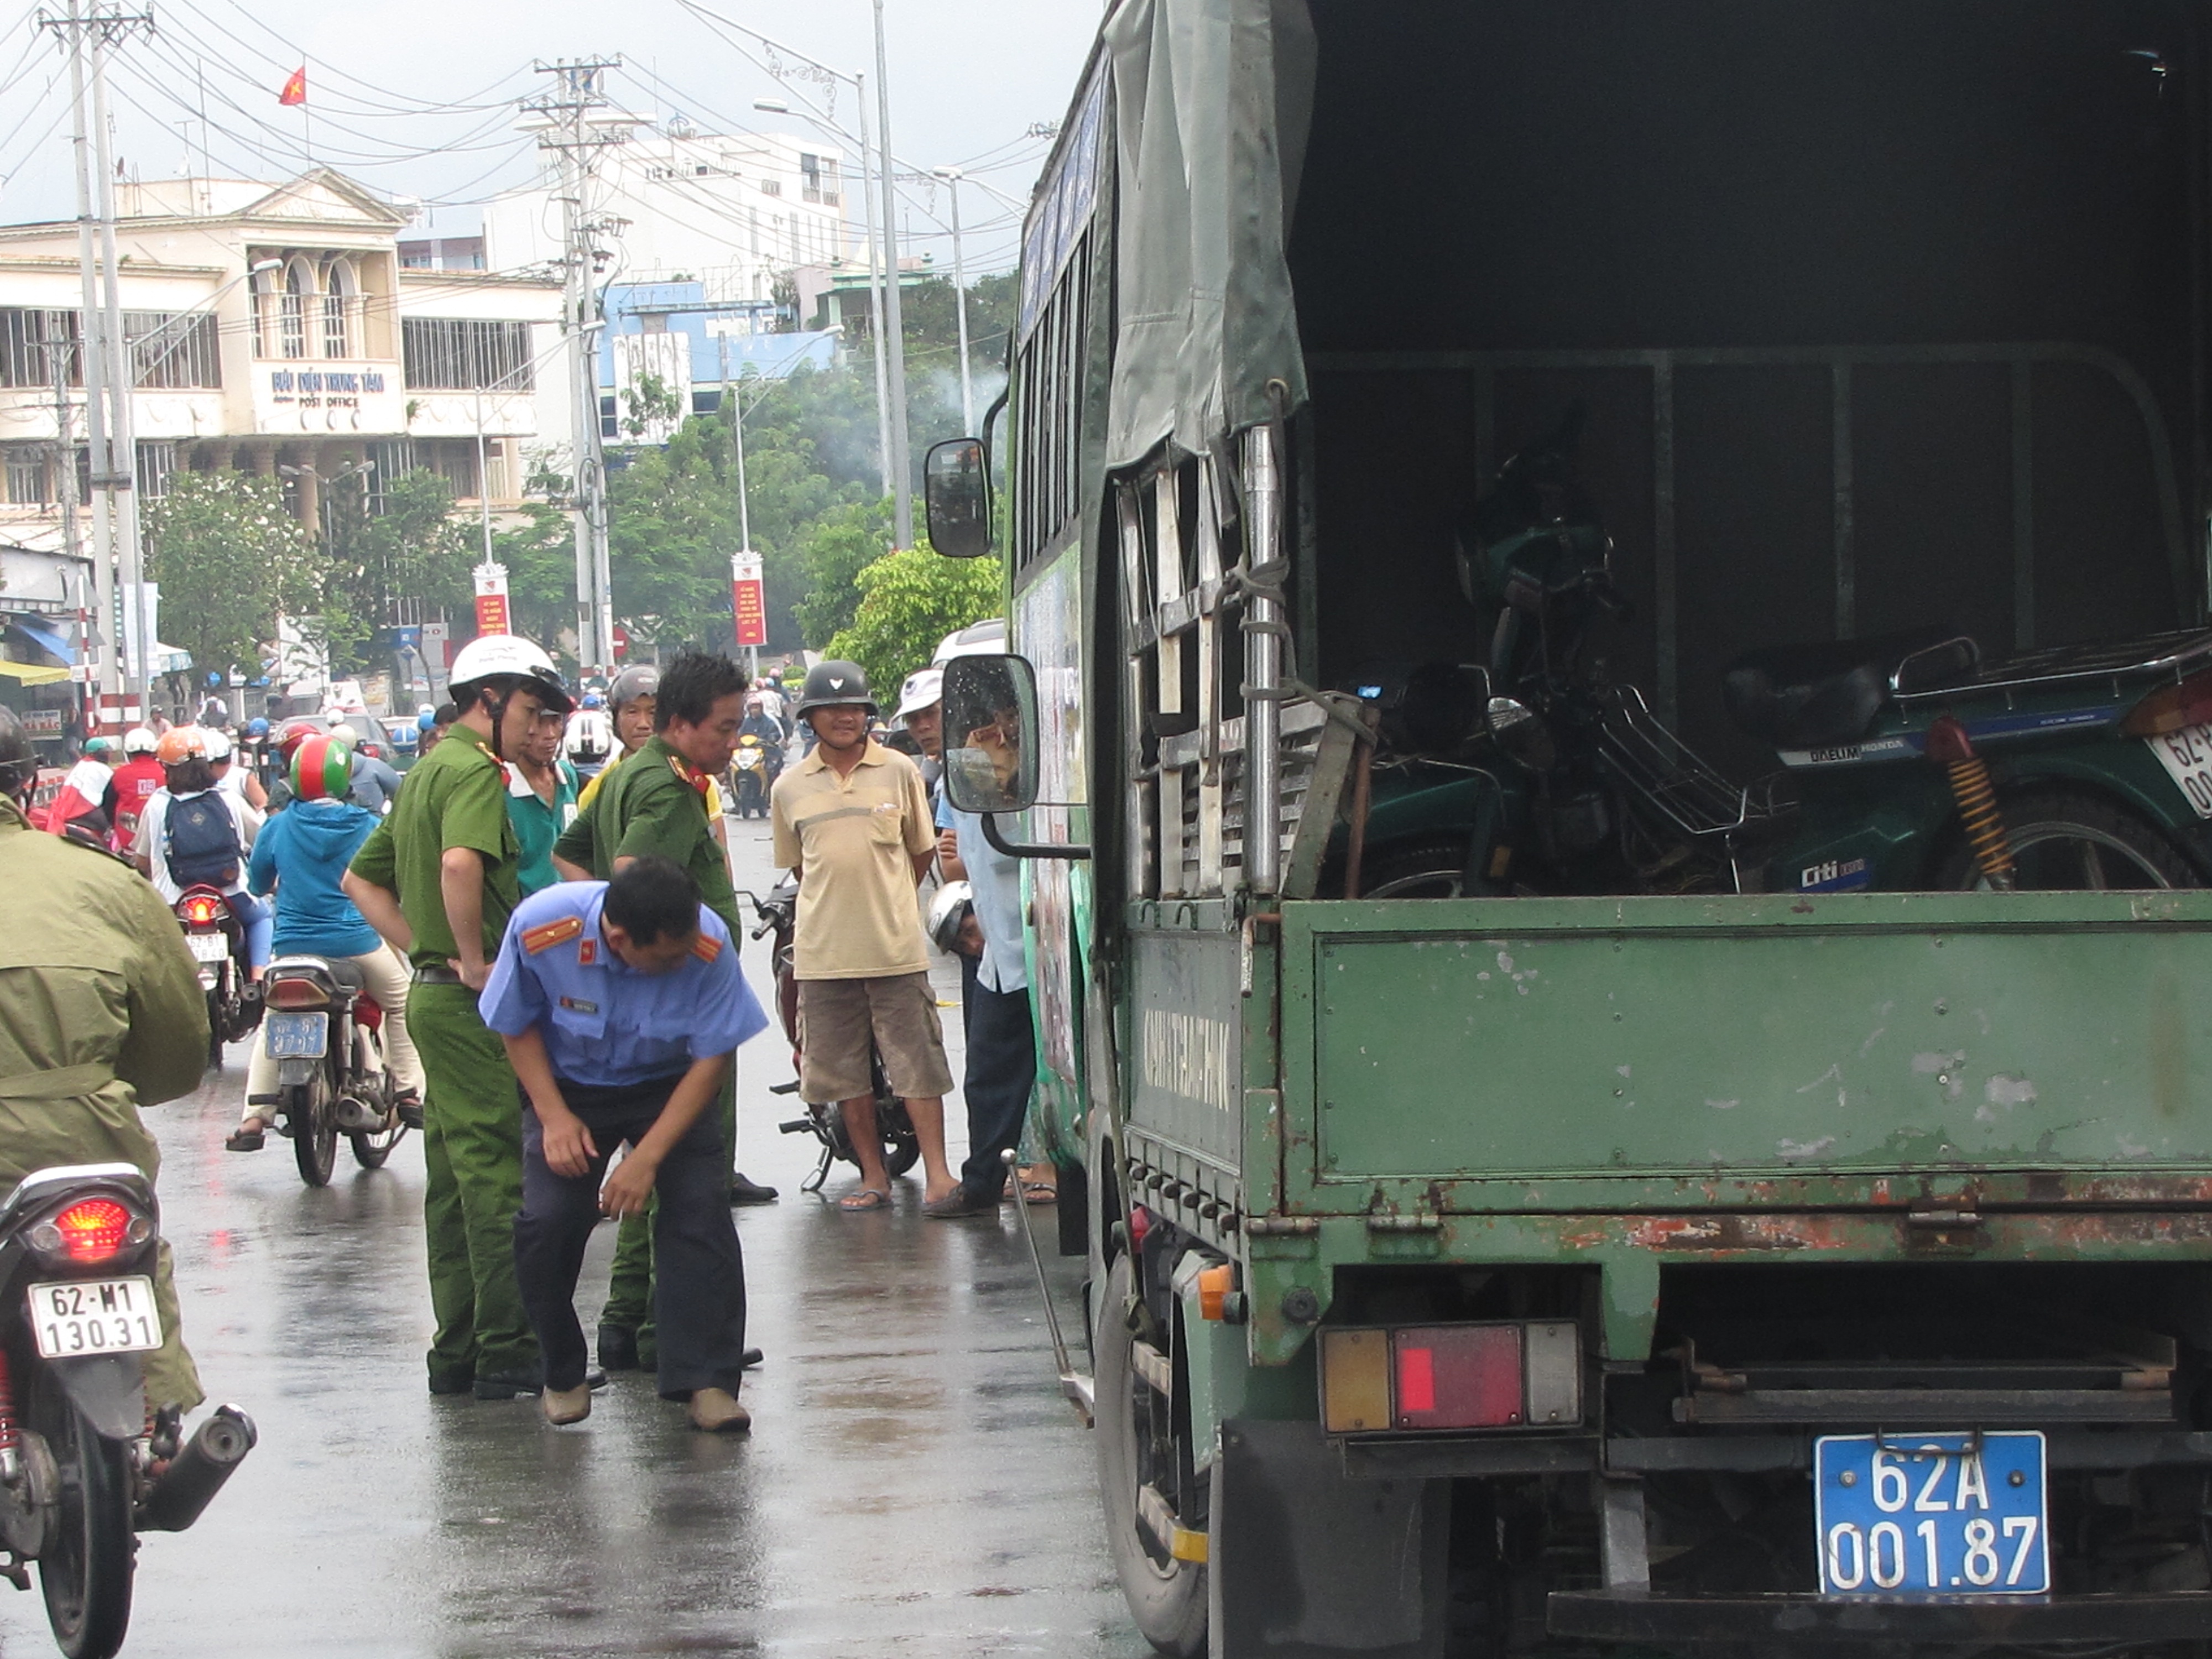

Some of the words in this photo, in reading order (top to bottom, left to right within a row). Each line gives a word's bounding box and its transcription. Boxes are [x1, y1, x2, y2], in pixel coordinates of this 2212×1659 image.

[299, 397, 321, 408] POST
[326, 397, 358, 408] OFFICE
[1810, 749, 1860, 762] DAELIM
[1861, 740, 1904, 752] HONDA
[1802, 860, 1838, 888] Citi
[51, 1283, 132, 1316] 62-M1
[47, 1315, 152, 1353] 130.31
[1871, 1442, 1990, 1512] 62A
[1828, 1515, 2038, 1590] 001.87
